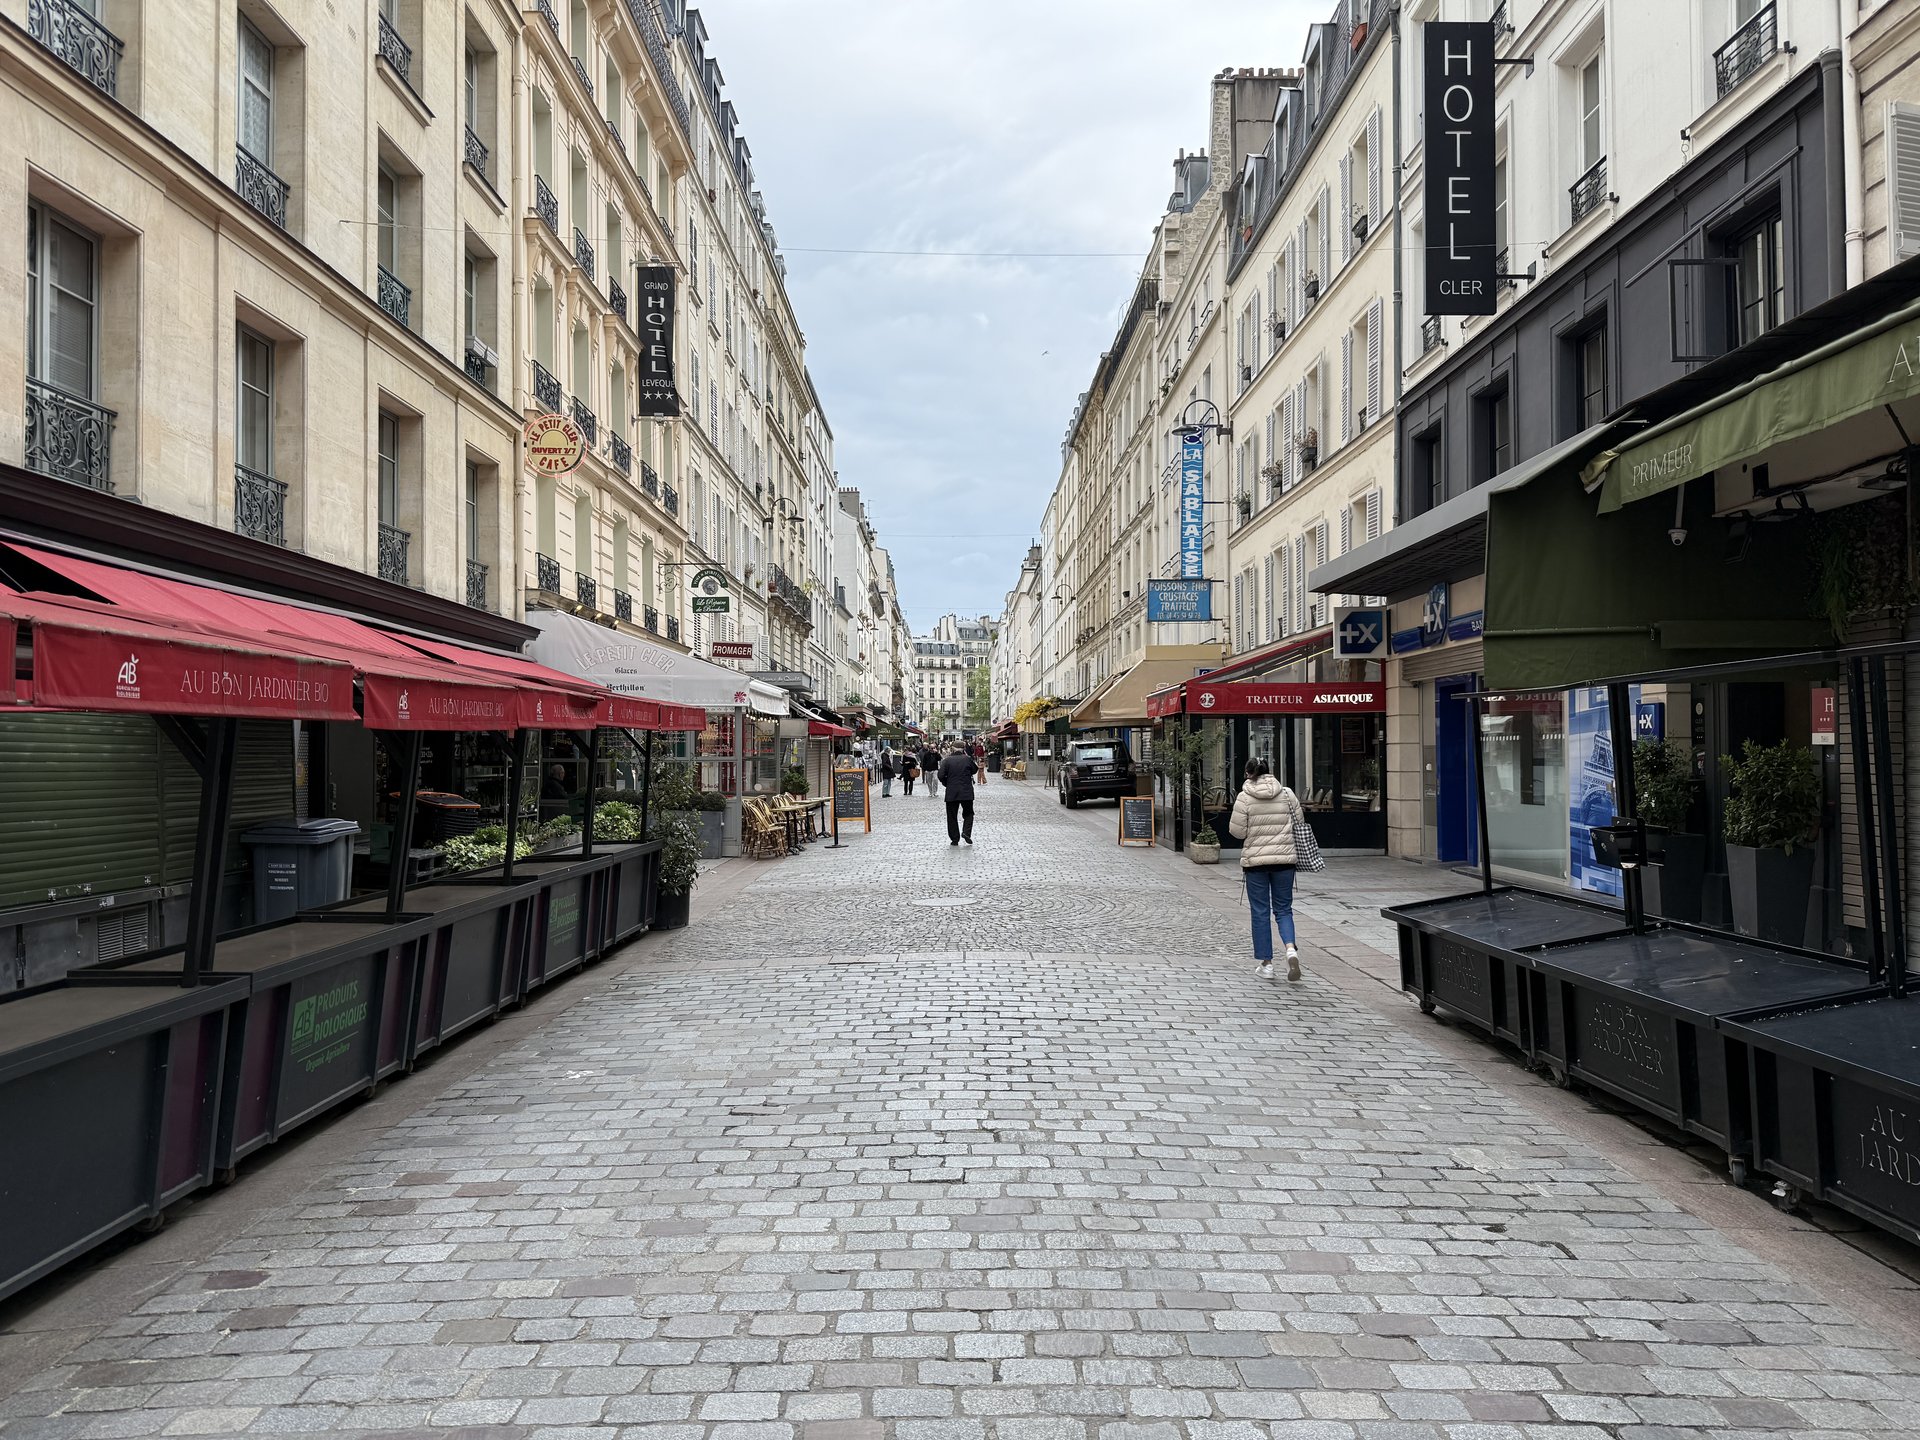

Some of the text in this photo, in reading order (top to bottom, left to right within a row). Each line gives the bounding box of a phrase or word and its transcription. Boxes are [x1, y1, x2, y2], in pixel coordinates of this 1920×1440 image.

[1443, 39, 1473, 260] HOTEL
[1439, 280, 1483, 296] CLER
[646, 296, 667, 373] HOTEL
[1886, 335, 1920, 384] A
[642, 379, 675, 388] LEVEQUE
[530, 419, 578, 442] LE PETIT CLER
[1183, 448, 1202, 460] LA
[1633, 444, 1692, 487] PRIMEUR
[1184, 469, 1201, 577] SABLAISE
[1150, 582, 1208, 591] POISSONS FINS
[1160, 602, 1197, 611] TRAITEUR
[575, 645, 675, 674] LE PETIT CLER
[713, 645, 752, 656] FROMAGER
[118, 661, 137, 685] AB
[180, 669, 329, 703] AU BON JARDINIER BIO
[428, 698, 440, 714] AU
[461, 700, 494, 718] JARDINIER
[1246, 693, 1374, 705] TRAITEUR ASIATIQUE
[1824, 697, 1834, 712] H
[317, 980, 358, 1014] PRODUITS
[314, 1001, 368, 1043] BIOLOGIQUES
[1588, 1023, 1664, 1075] JARDINIER
[305, 1054, 325, 1073] Organic
[1870, 1105, 1907, 1142] AU
